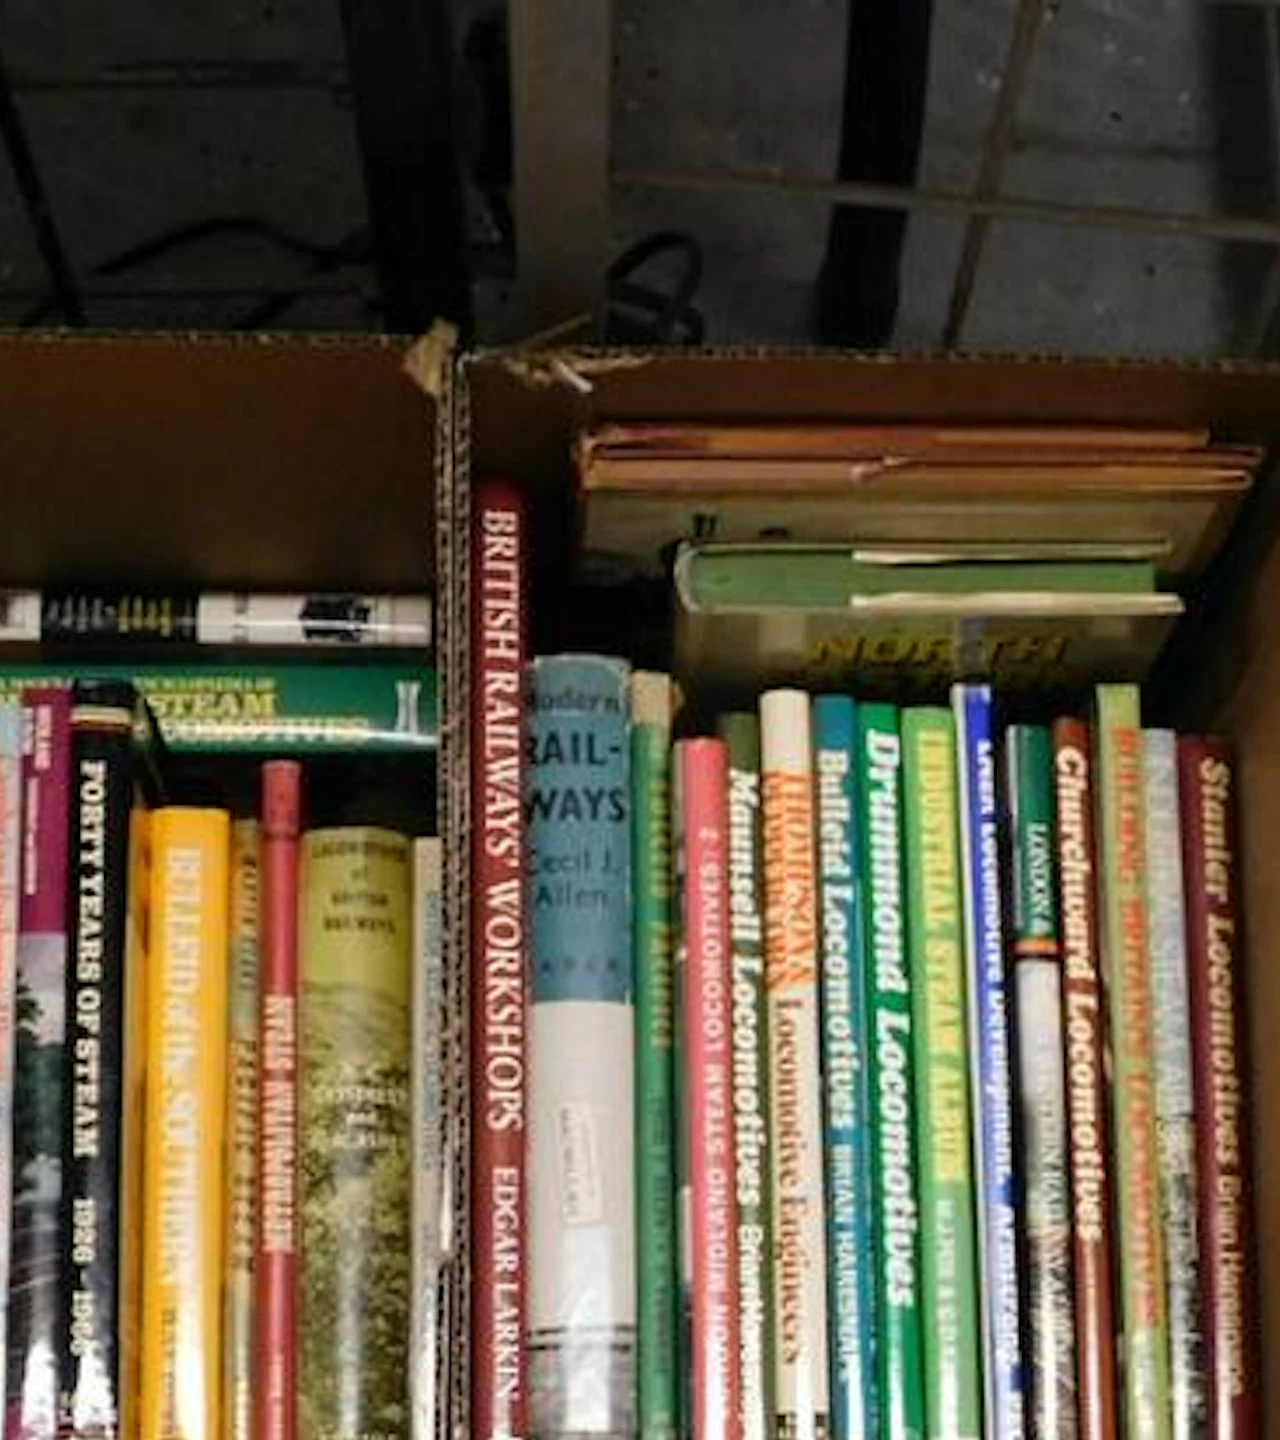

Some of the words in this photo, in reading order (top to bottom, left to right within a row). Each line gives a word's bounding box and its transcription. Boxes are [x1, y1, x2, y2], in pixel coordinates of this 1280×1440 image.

[478, 509, 521, 659] BRITISH
[79, 760, 108, 868] FORTY
[483, 669, 524, 869] RAILWAYS'
[725, 768, 764, 941] Maunsell
[816, 750, 853, 877] Bulleid
[1196, 757, 1234, 900] Stanier
[77, 870, 105, 982] YEARS
[864, 729, 908, 994] Drummond
[1055, 746, 1095, 981] Churchward
[76, 988, 103, 1036] OF
[485, 882, 524, 1132] WORKSHOPS
[728, 953, 768, 1206] Locomotives
[821, 886, 860, 1129] Locomotives
[1203, 915, 1241, 1168] Locomotives
[72, 1039, 102, 1159] STEAM
[775, 999, 812, 1189] Locomotive
[871, 1008, 918, 1309] Locomotives
[927, 1062, 968, 1182] ALBUM
[1065, 991, 1103, 1242] Locomotives
[490, 1166, 519, 1260] EDGAR
[771, 1198, 813, 1368] Engineers
[491, 1269, 521, 1400] LARKIN
